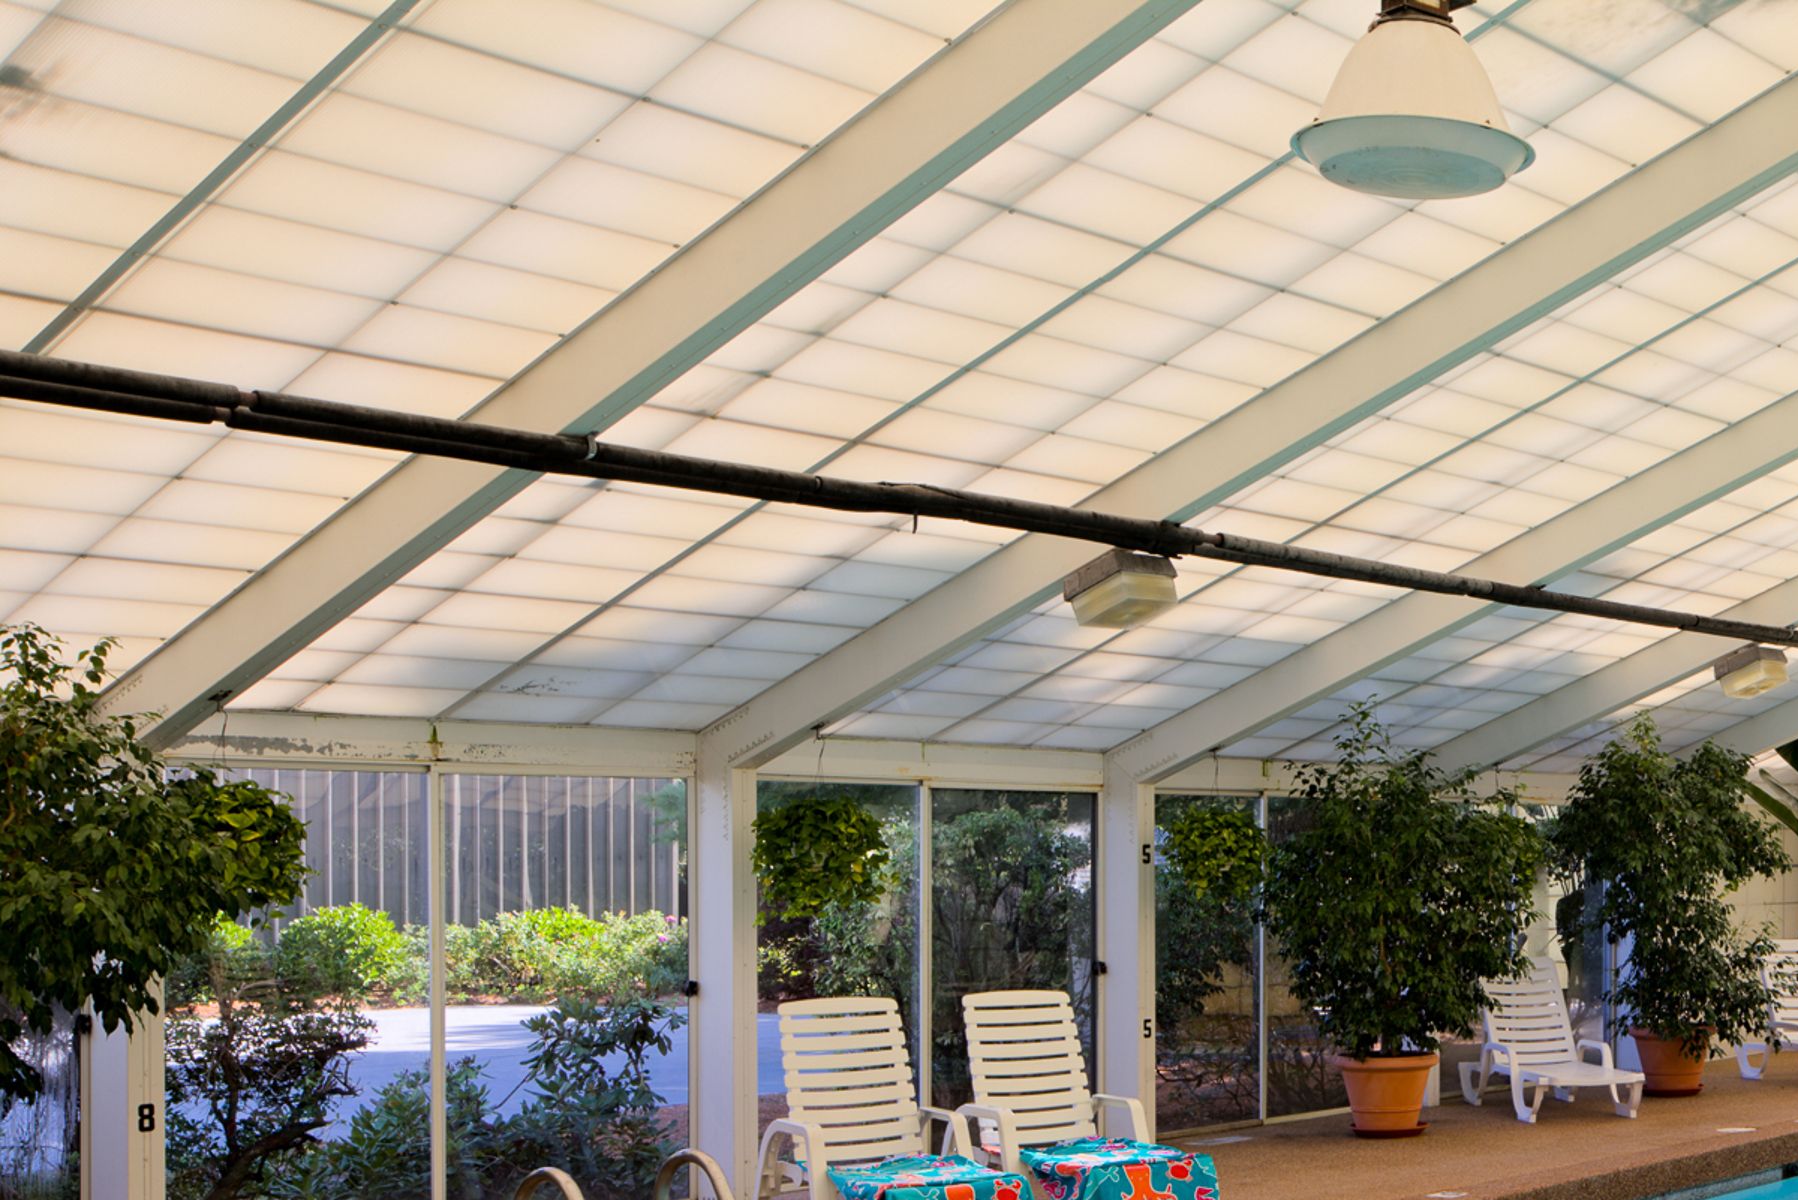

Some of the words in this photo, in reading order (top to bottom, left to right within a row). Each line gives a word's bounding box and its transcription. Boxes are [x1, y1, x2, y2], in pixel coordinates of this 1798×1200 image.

[1142, 844, 1151, 864] 5
[1143, 1018, 1152, 1039] 5
[138, 1103, 155, 1132] 8
